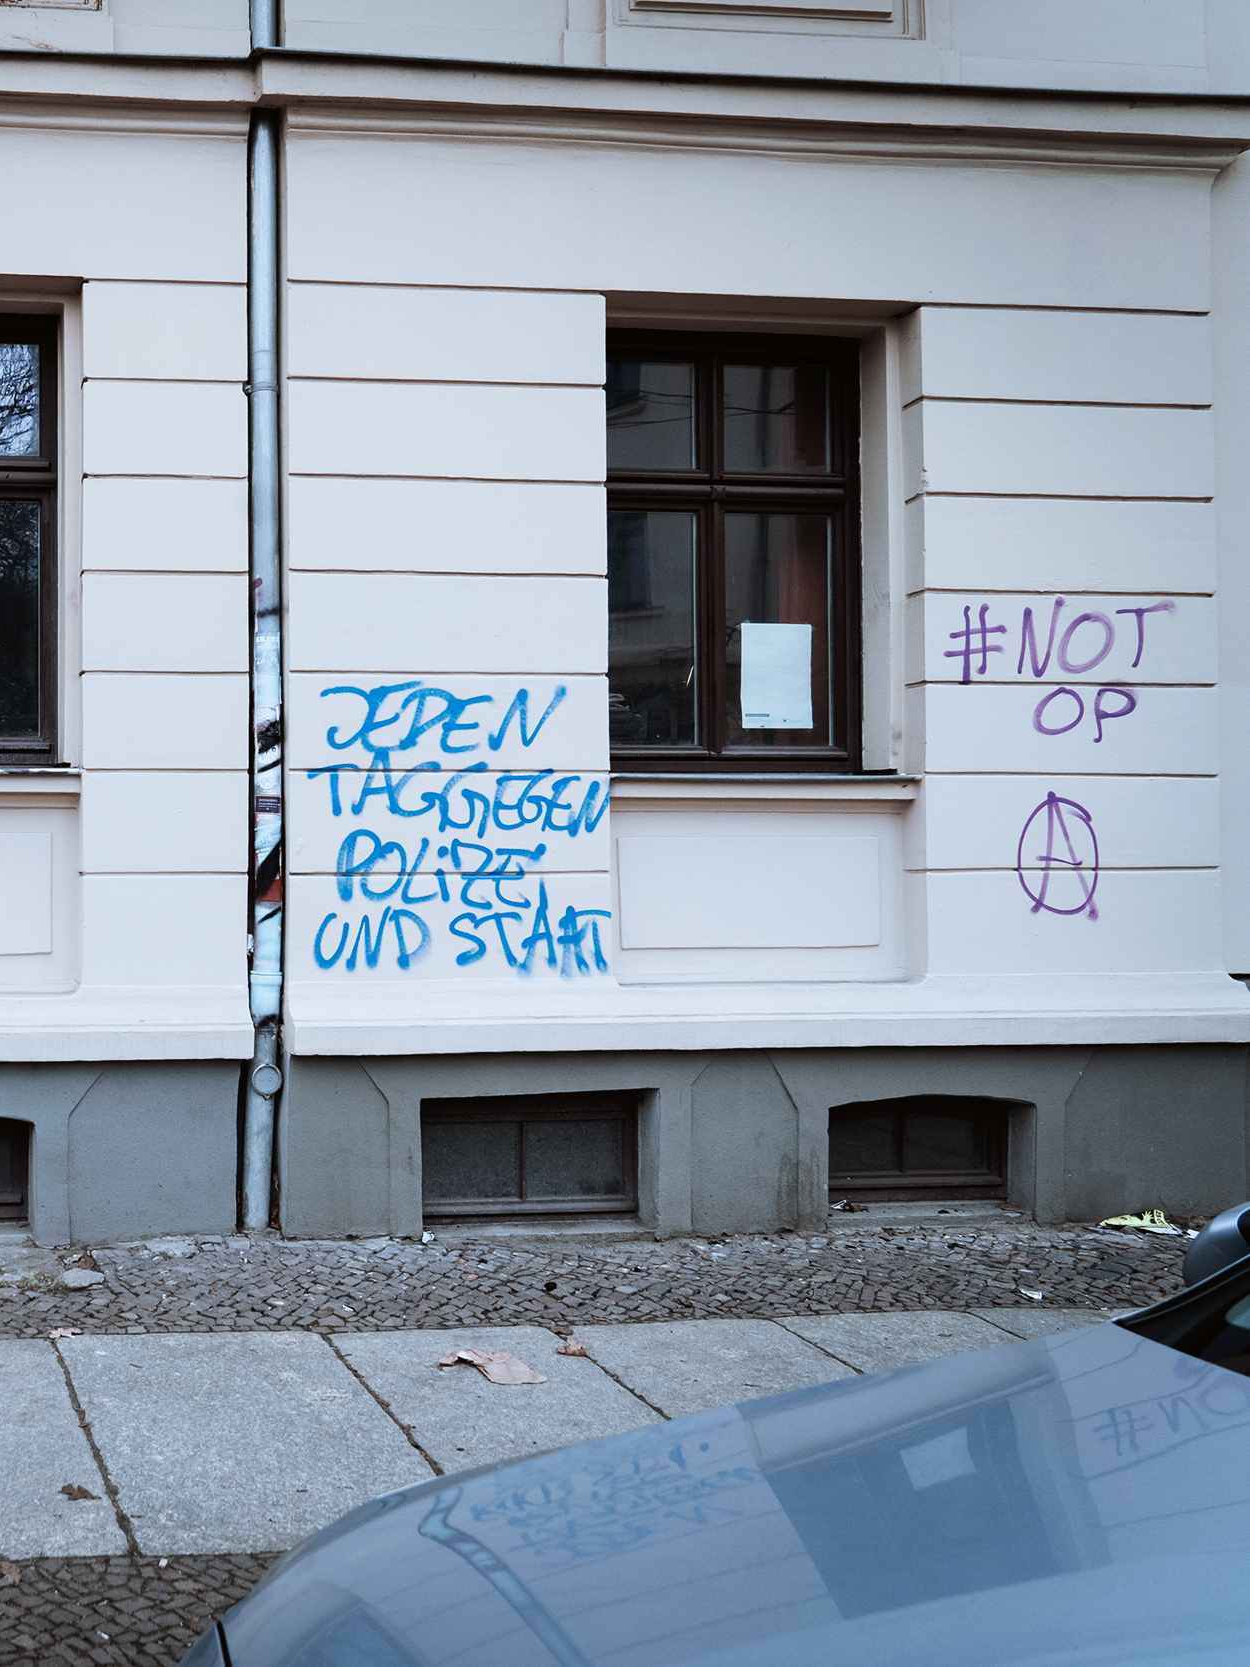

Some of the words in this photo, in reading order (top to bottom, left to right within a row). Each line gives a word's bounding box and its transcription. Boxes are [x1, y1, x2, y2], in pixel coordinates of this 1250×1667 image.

[944, 597, 1176, 685] #NOT
[320, 681, 567, 752] JEDEN
[1034, 686, 1137, 743] OP
[313, 905, 432, 972] UND
[449, 905, 612, 979] STAAT
